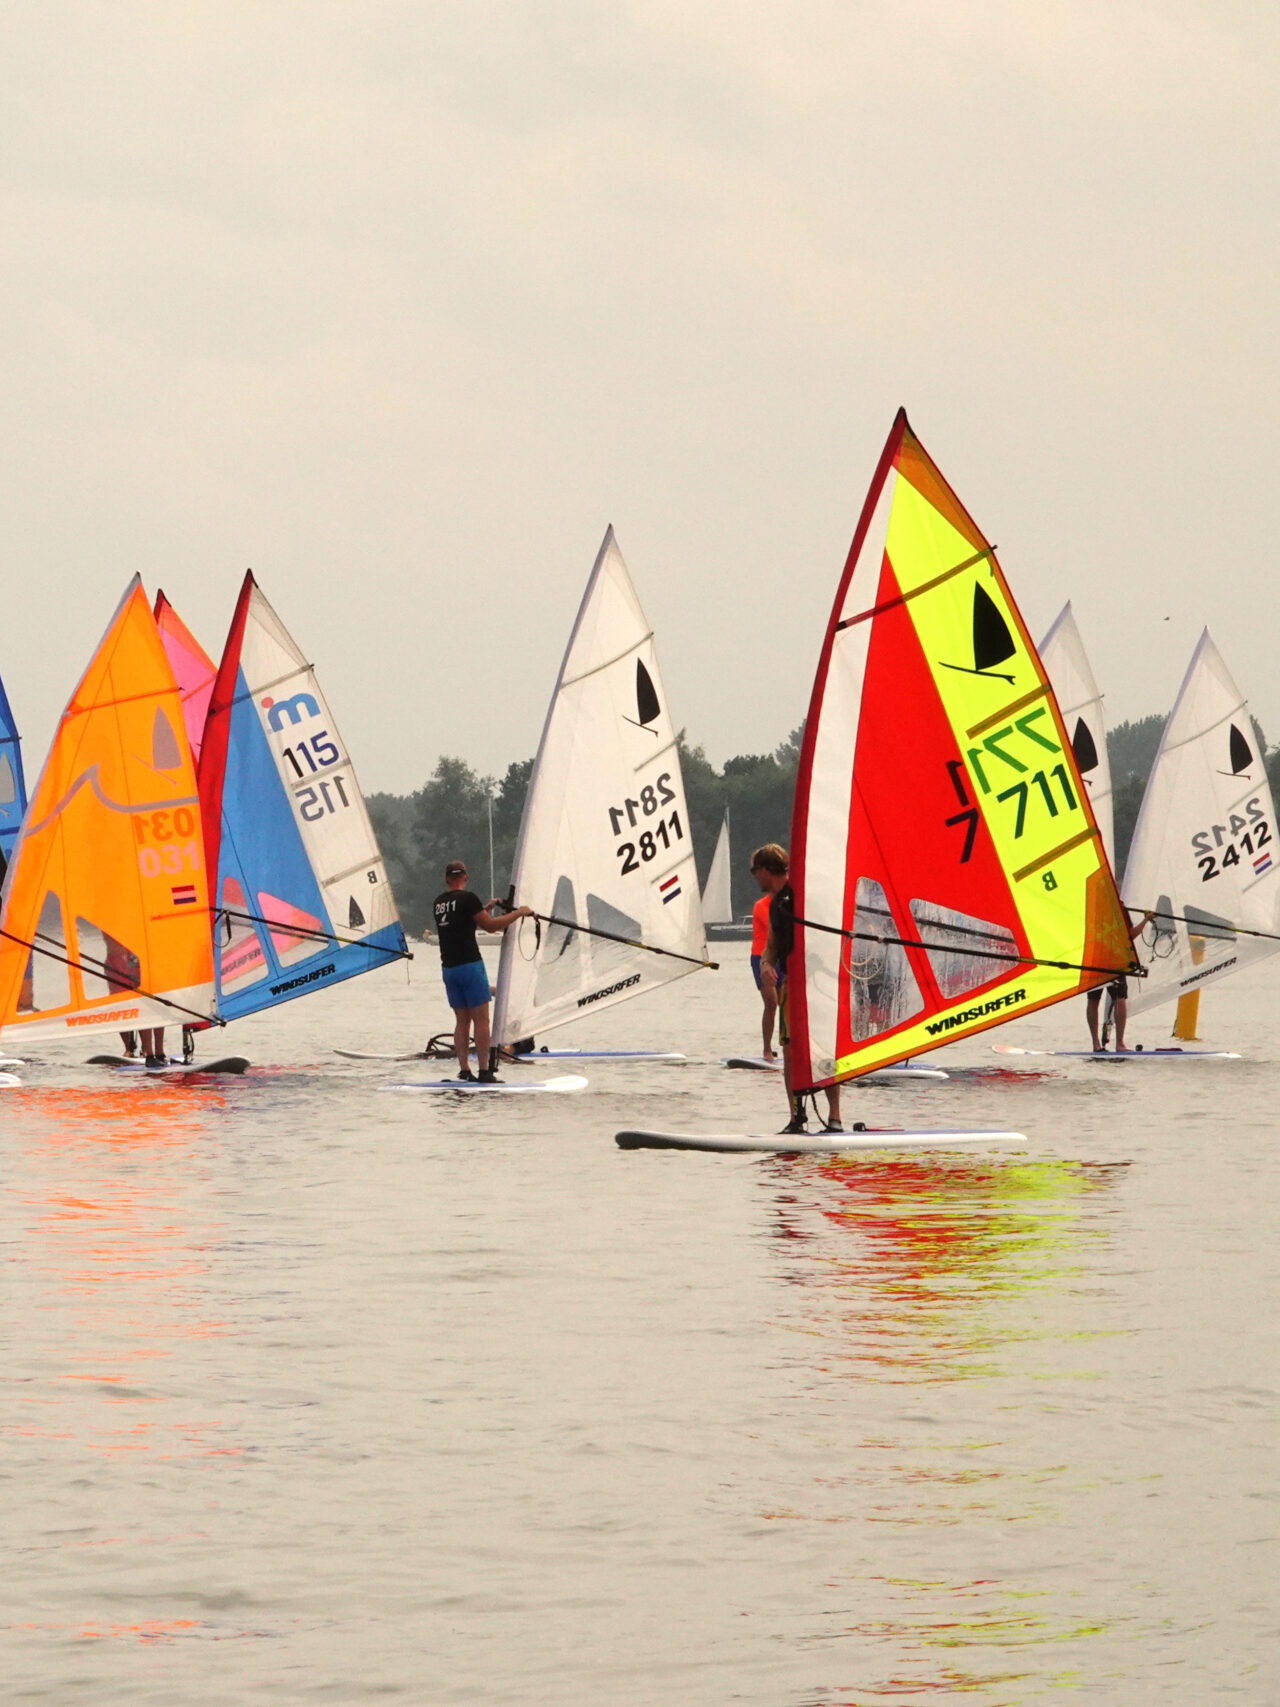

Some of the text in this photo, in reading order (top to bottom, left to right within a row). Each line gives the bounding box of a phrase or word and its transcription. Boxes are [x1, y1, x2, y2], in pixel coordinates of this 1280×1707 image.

[282, 730, 340, 779] 115
[138, 839, 200, 878] 031
[616, 809, 684, 877] 2811
[1197, 821, 1273, 883] 2412
[435, 900, 457, 915] 2811
[268, 963, 336, 996] WINDSURFER
[577, 973, 641, 1008] WINDSURFER
[1179, 956, 1238, 988] WINDSURFER
[65, 1007, 139, 1028] WINDSURFER
[925, 988, 1026, 1036] WINDSURFER
